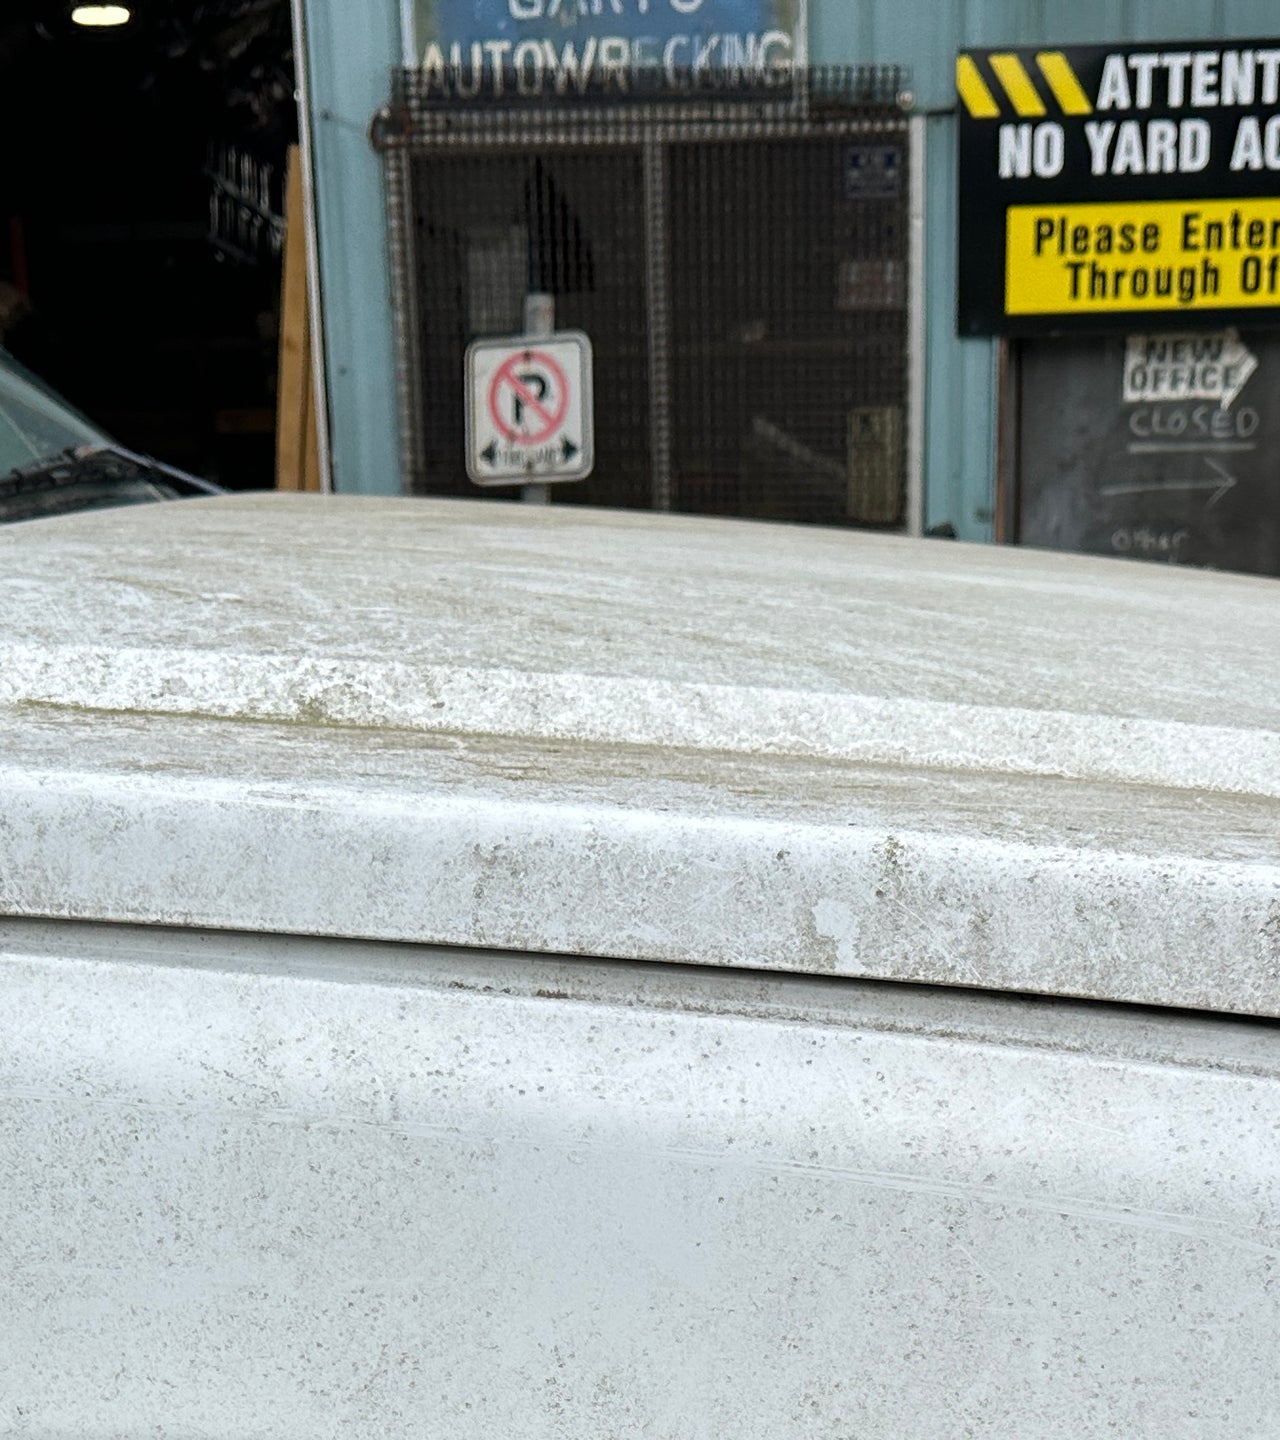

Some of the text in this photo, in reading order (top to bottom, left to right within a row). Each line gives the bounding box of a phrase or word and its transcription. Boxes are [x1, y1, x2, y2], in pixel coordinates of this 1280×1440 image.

[998, 122, 1065, 178] NO
[1085, 117, 1211, 175] YARD
[1033, 216, 1160, 256] Please
[1066, 258, 1221, 303] Through
[1144, 337, 1222, 364] NEW
[1130, 364, 1239, 392] OFFICE
[1128, 405, 1261, 438] CLOSED
